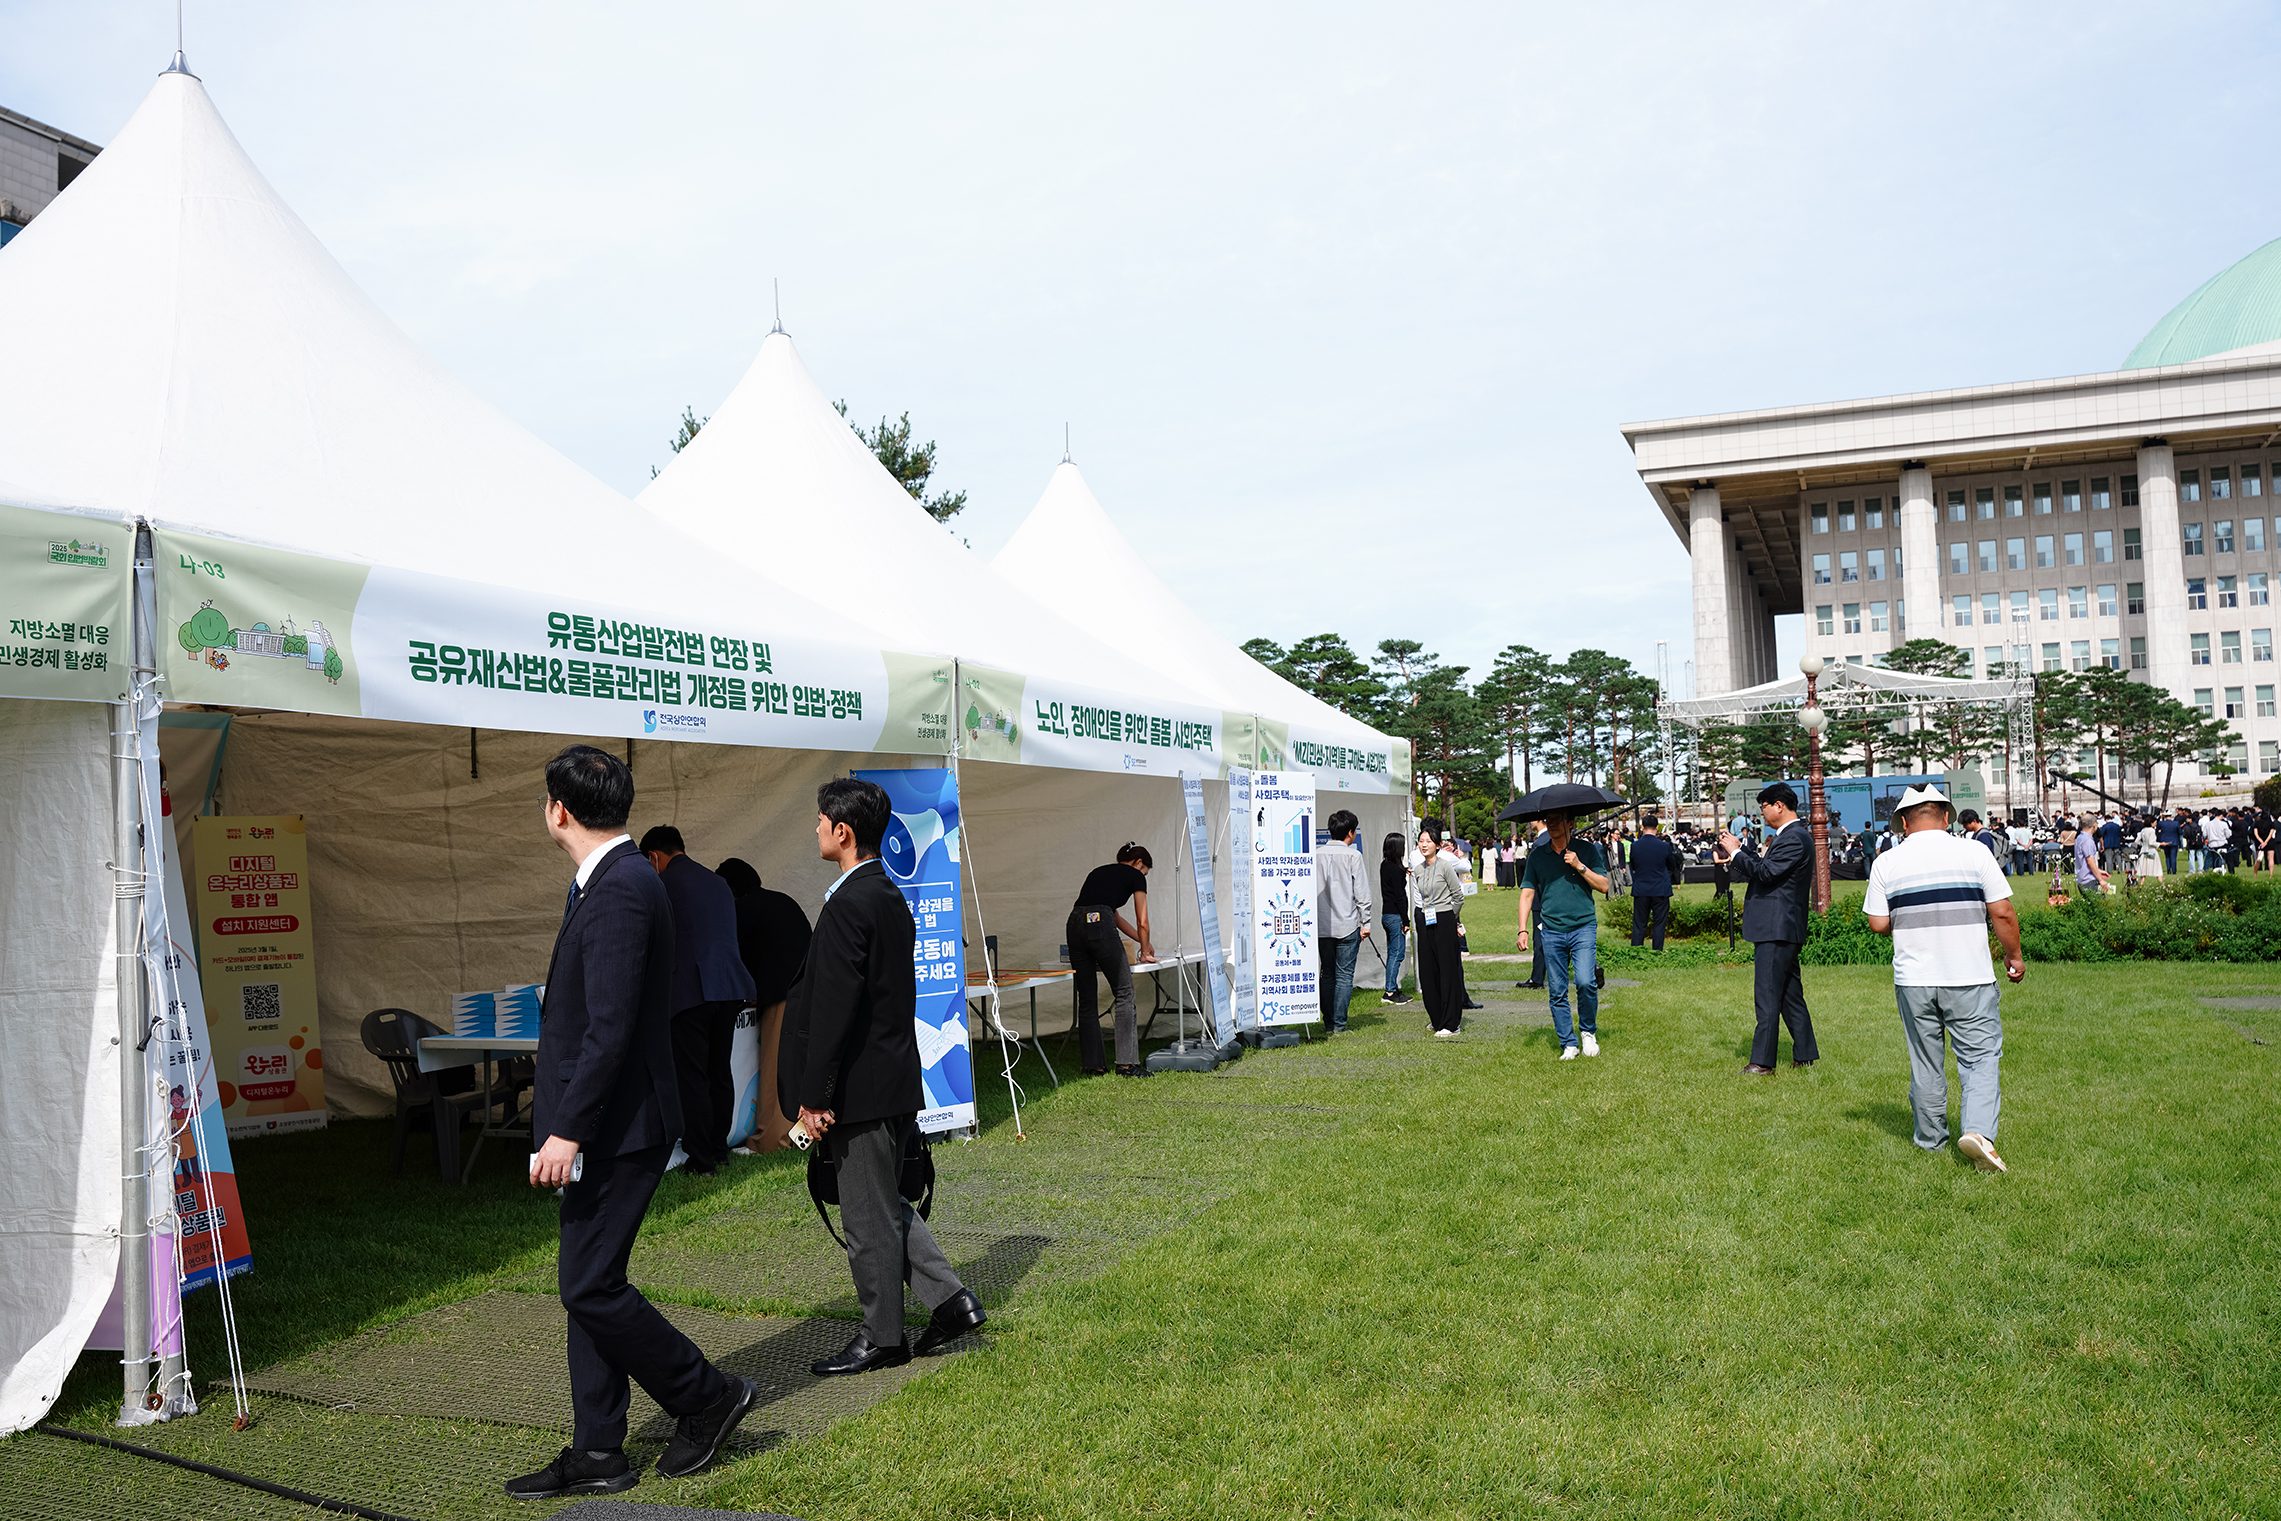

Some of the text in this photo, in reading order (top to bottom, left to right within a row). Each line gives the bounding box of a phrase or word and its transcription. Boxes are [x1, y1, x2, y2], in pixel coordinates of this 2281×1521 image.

[51, 543, 68, 552] 2025
[51, 551, 67, 562] 국회
[180, 554, 226, 580] 나-03
[9, 619, 110, 645] 지방소멸 대응
[547, 611, 773, 675] 유통산업발전법 연장 및
[0, 645, 108, 672] 민생경제 활성화
[408, 640, 682, 706] 공유재산법&물품관리법
[687, 673, 747, 711] 개정을
[751, 680, 788, 715] 위한
[660, 713, 707, 728] 전국상인연합회
[1035, 699, 1214, 752] 노인, 장애인을 위한 돌봄 사회주택
[230, 856, 275, 872] 디지털
[1257, 856, 1278, 866] 사회적
[1276, 868, 1296, 877] 가구의
[208, 873, 298, 892] 온누리상품권
[230, 893, 279, 909] 통합 앱
[918, 897, 954, 913] 상권을
[221, 918, 291, 932] 설치 지원센터
[924, 913, 937, 928] 법
[915, 962, 957, 982] 주세요
[1261, 985, 1288, 995] 지역사회
[1279, 1004, 1291, 1016] SE
[1290, 1002, 1318, 1011] empower
[246, 1086, 288, 1096] 디지털온누리
